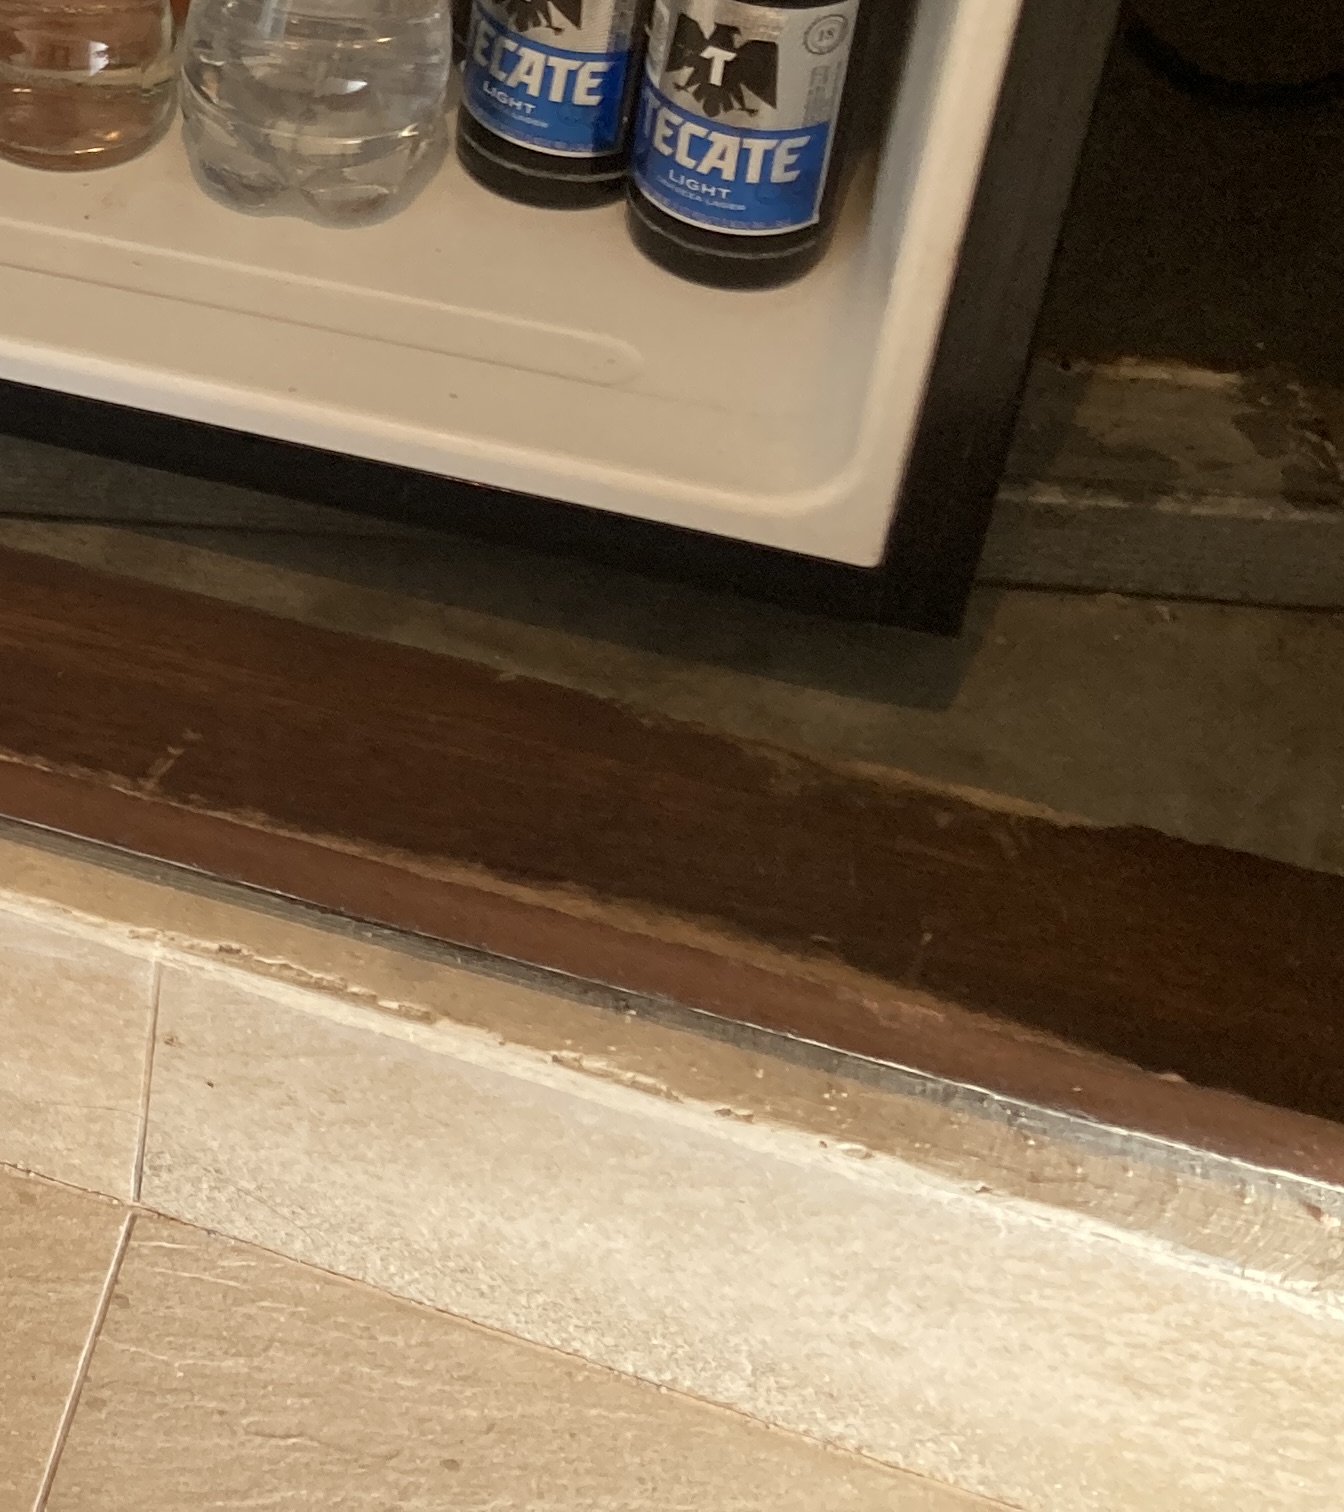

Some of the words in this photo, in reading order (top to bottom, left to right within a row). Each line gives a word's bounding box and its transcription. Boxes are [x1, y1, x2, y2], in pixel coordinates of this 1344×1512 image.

[471, 18, 614, 107] ECATE
[699, 45, 738, 87] T
[482, 79, 537, 115] LIGHT
[668, 168, 732, 210] LIGHT
